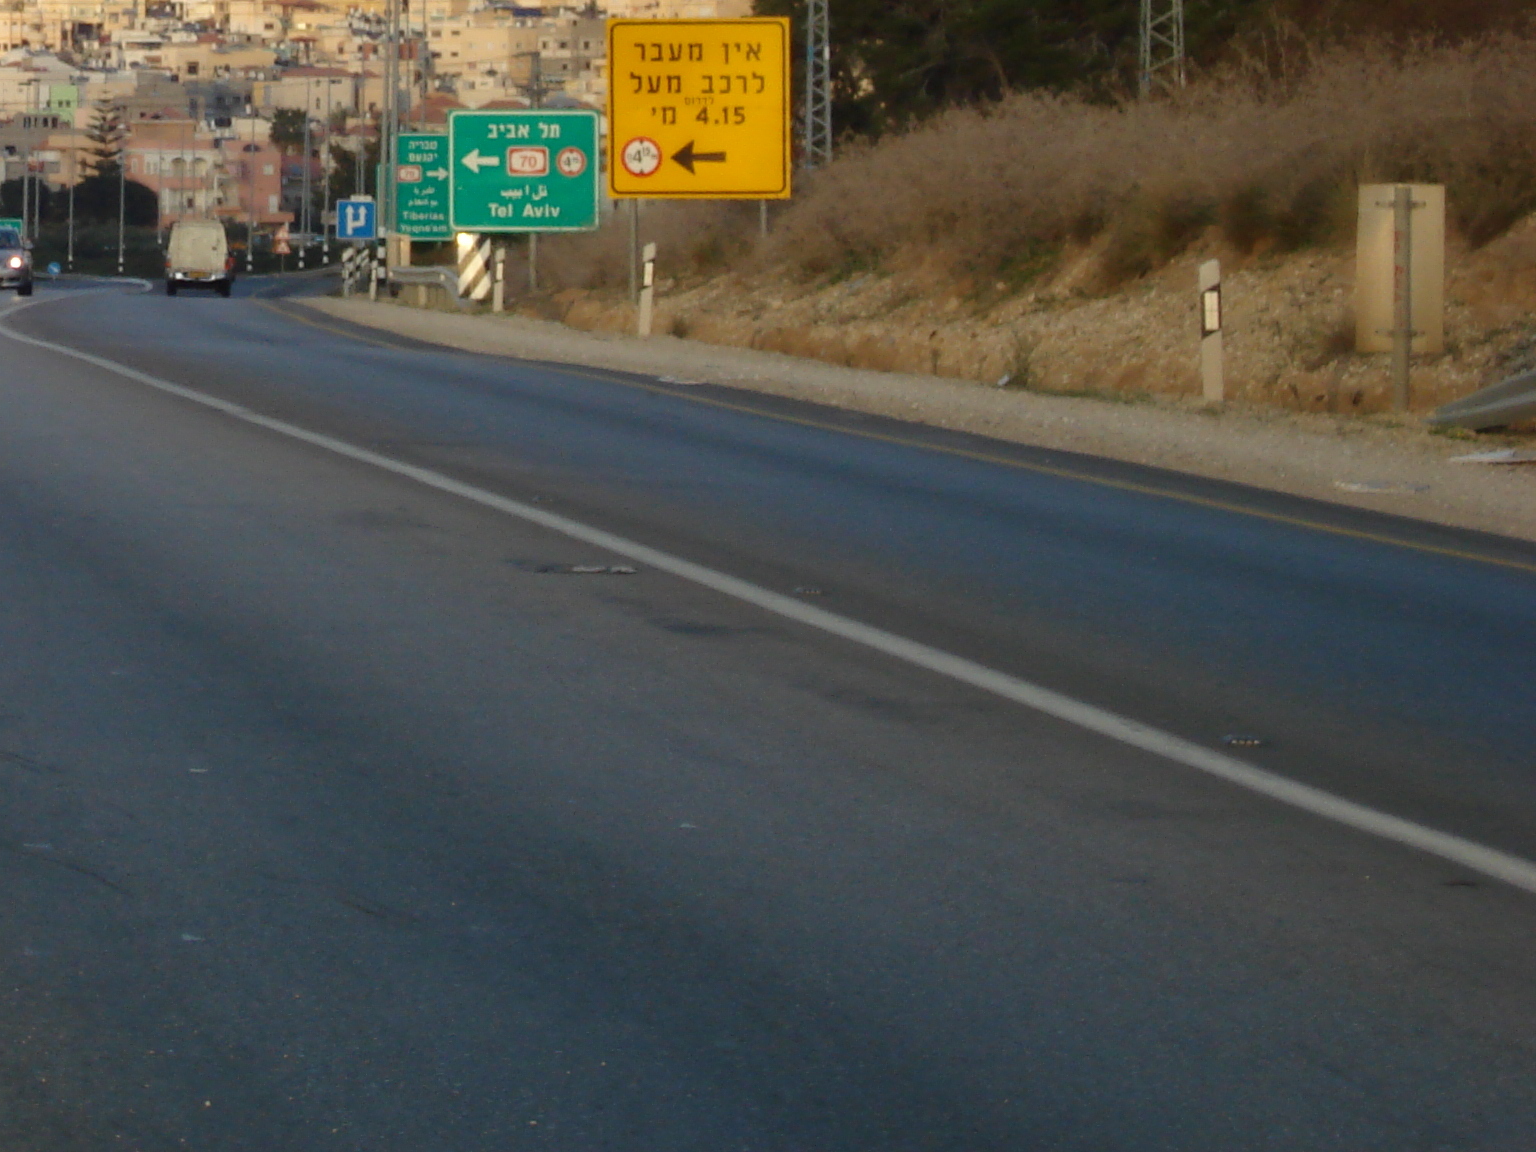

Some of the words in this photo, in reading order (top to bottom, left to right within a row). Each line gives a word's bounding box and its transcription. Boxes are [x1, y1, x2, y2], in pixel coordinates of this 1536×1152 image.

[633, 42, 704, 62] מעבר
[722, 42, 762, 65] אין
[629, 71, 682, 94] מעל
[701, 71, 765, 94] לרכב
[695, 106, 746, 125] 4.15
[487, 123, 531, 139] אביב
[538, 121, 561, 139] תל
[519, 155, 538, 169] 70
[402, 210, 444, 221] Tiberias
[488, 203, 513, 218] Tel
[522, 203, 560, 218] Aviv
